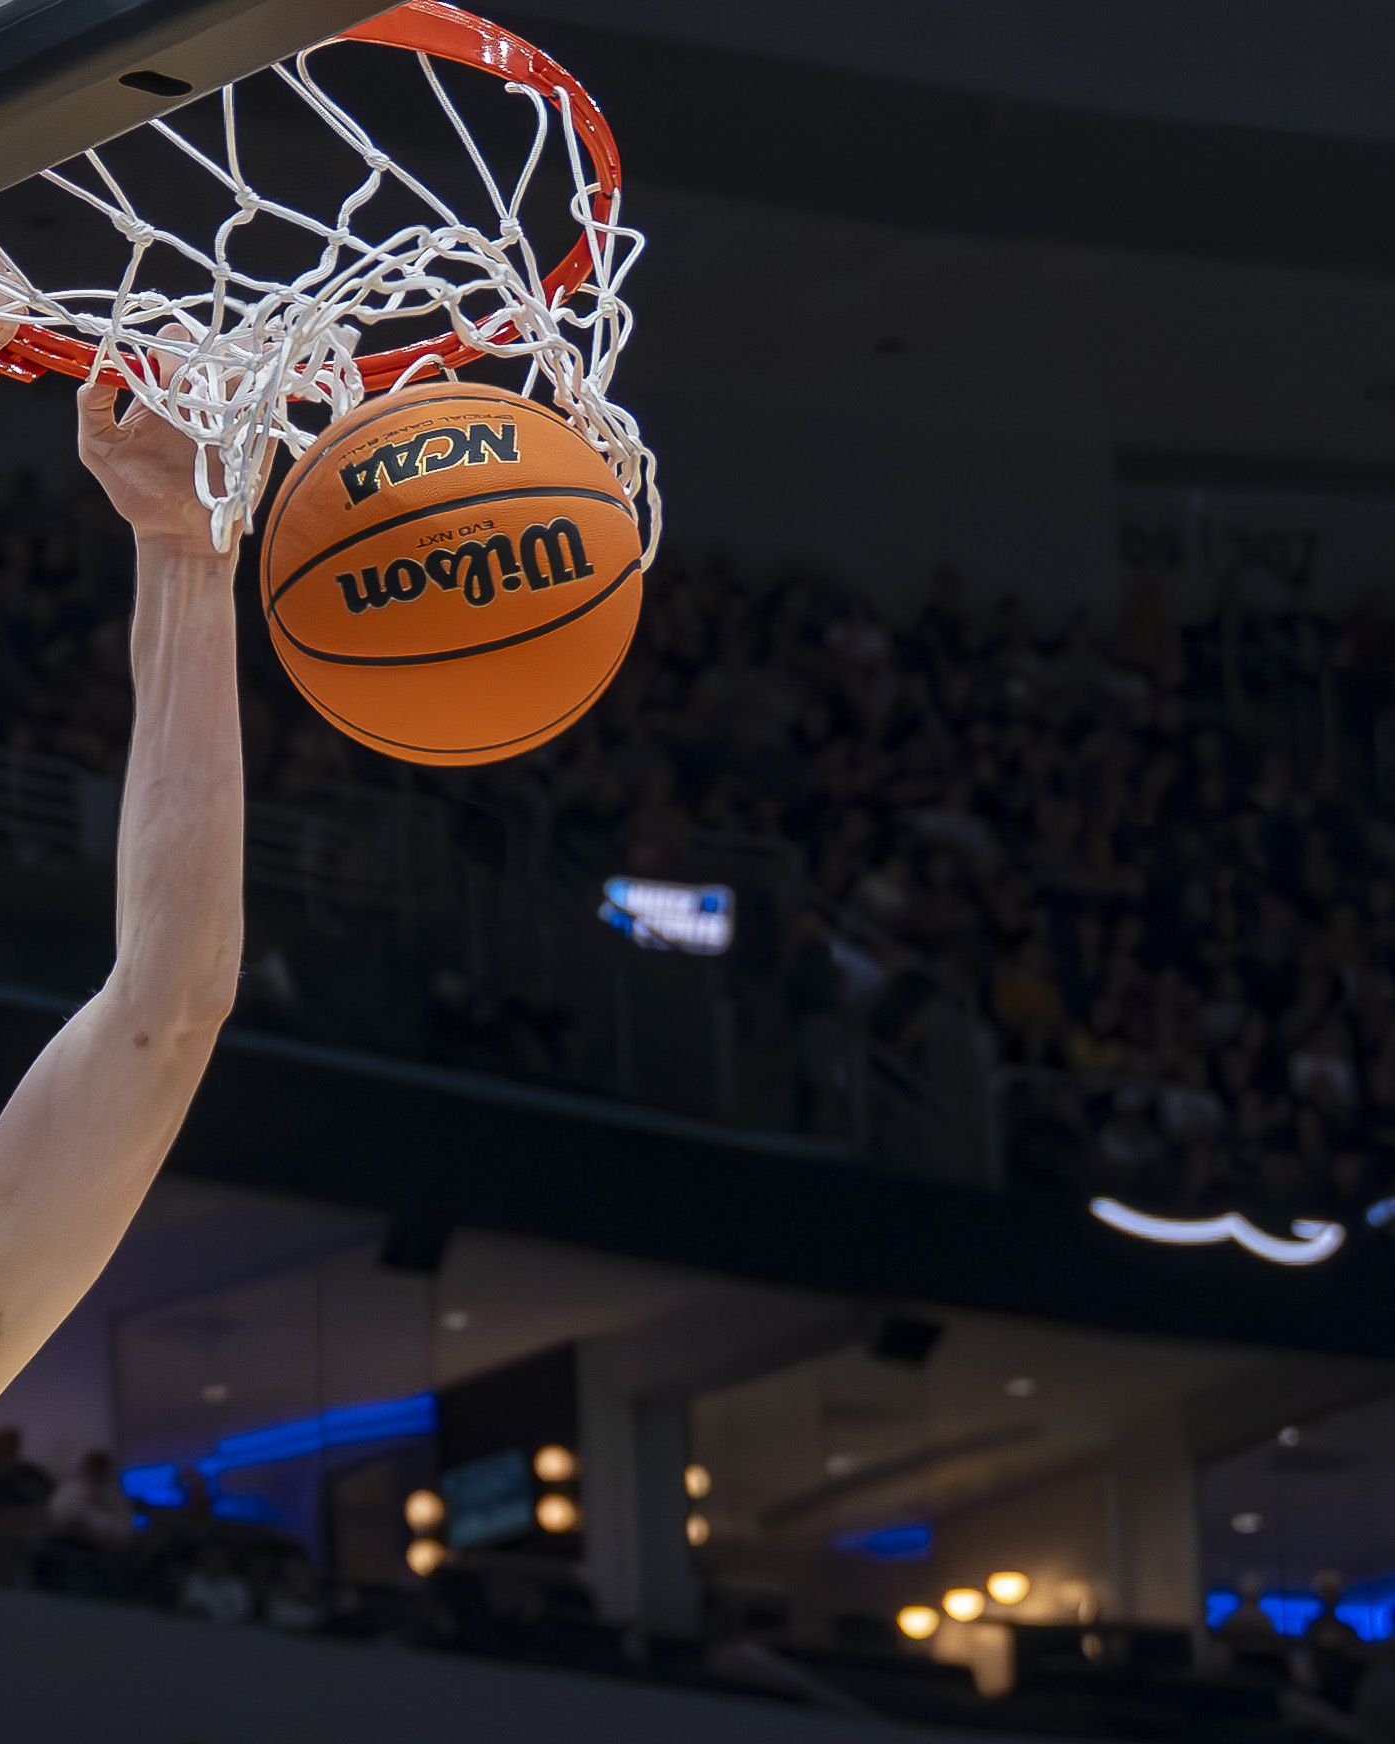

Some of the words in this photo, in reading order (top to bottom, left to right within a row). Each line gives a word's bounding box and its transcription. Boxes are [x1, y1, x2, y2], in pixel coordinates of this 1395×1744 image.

[338, 423, 520, 506] NCAA
[416, 530, 454, 549] NXT
[458, 519, 496, 537] EVO
[334, 516, 595, 615] Wilson
